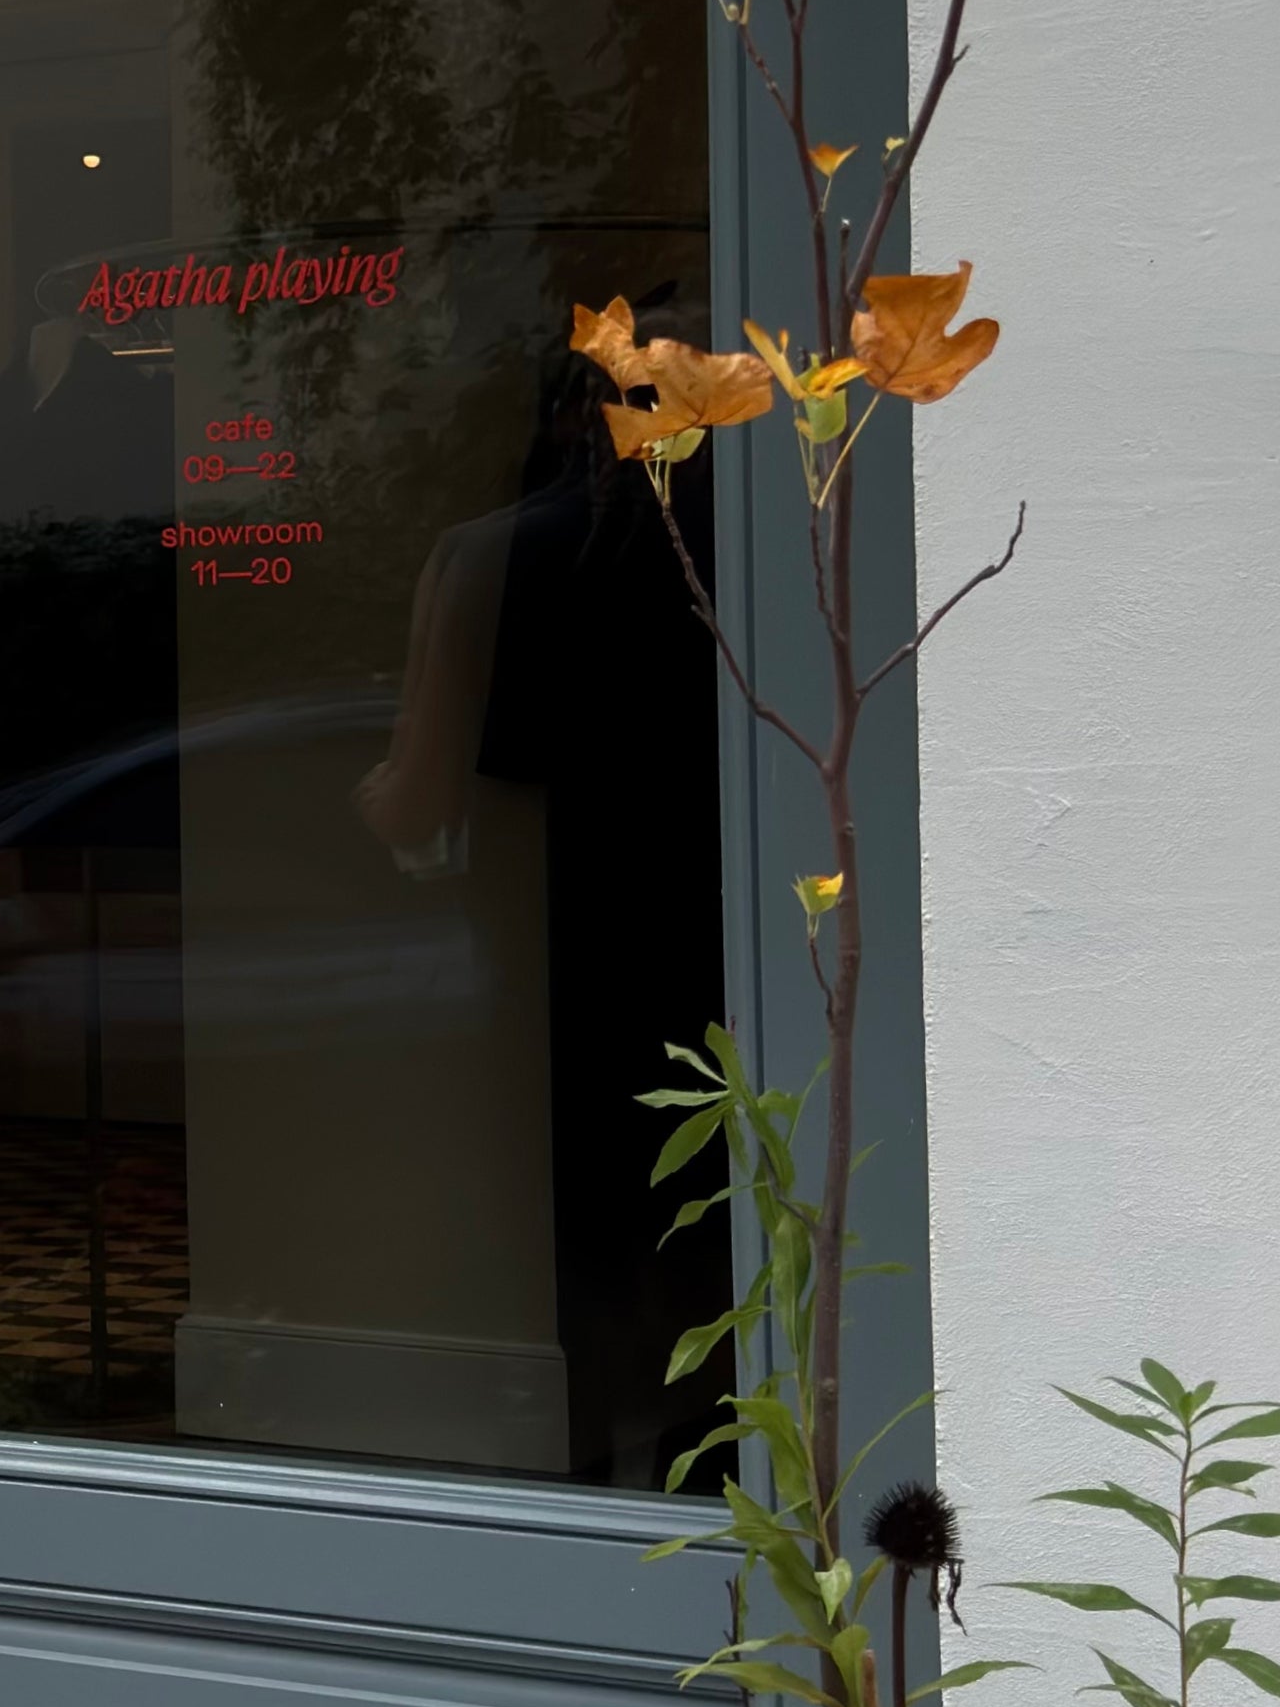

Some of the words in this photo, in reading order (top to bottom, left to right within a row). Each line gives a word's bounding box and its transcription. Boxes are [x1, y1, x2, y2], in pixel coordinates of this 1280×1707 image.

[78, 253, 233, 325] Agatha
[236, 245, 405, 315] playing
[205, 412, 274, 442] cafe
[160, 520, 324, 549] showroom
